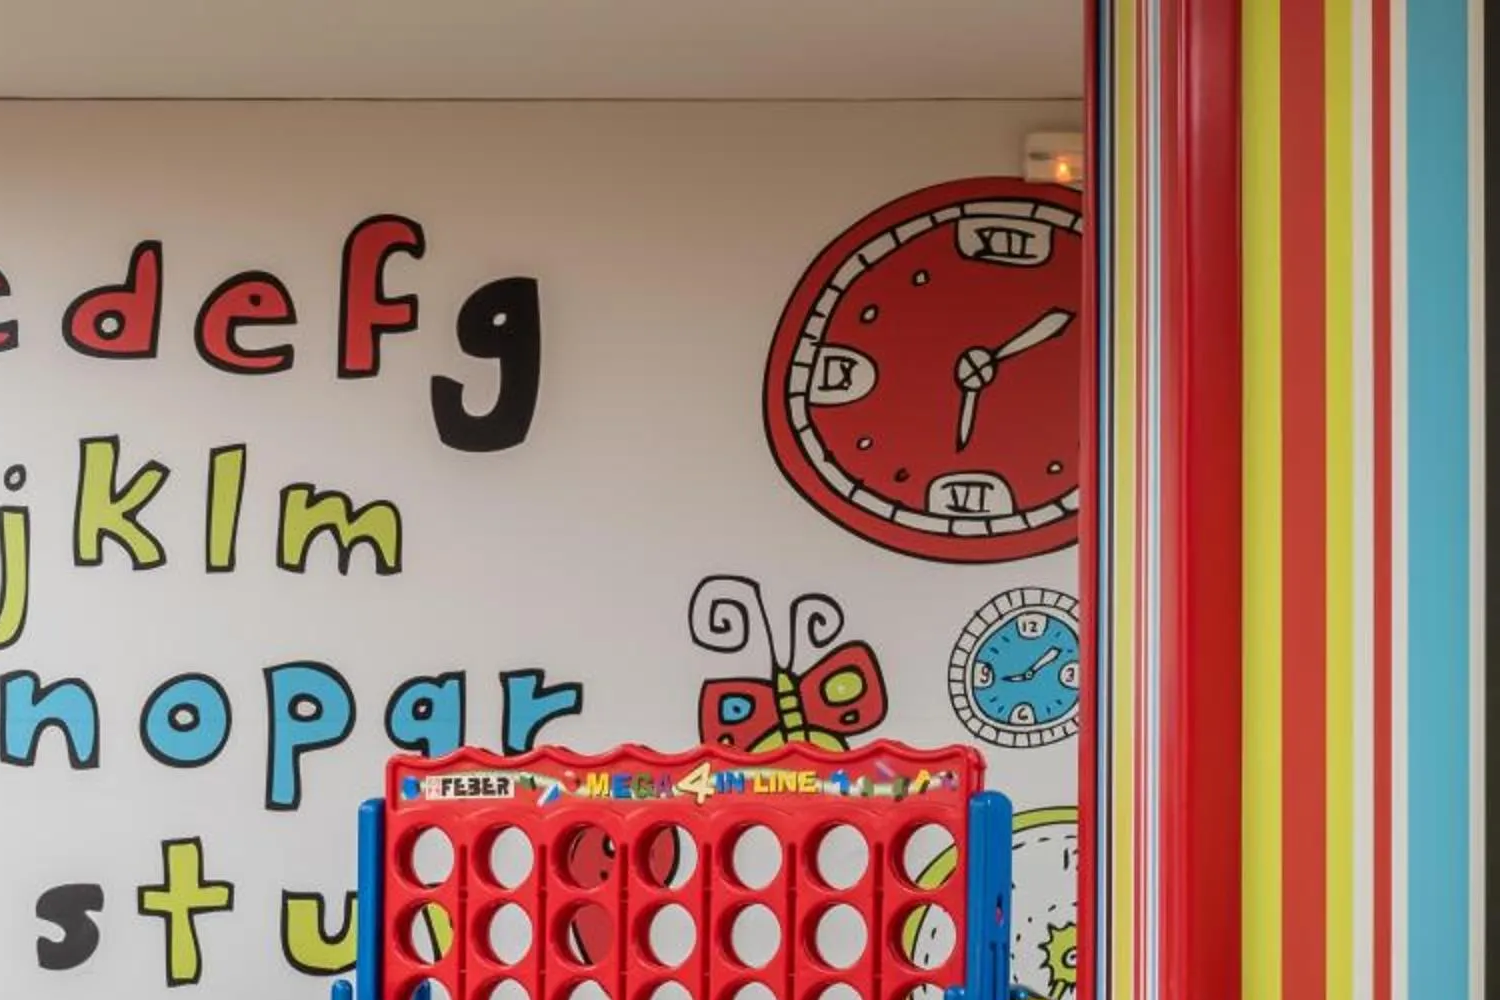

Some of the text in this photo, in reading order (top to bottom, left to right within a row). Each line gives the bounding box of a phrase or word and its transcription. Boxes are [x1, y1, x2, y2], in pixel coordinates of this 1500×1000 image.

[61, 239, 164, 360] d
[193, 270, 298, 376] e
[336, 213, 426, 380] f
[430, 276, 541, 453] g
[276, 481, 403, 576] m
[1021, 621, 1038, 633] 12
[979, 665, 1075, 683] 9 3
[1017, 706, 1028, 720] 6
[441, 762, 818, 804] FEBER MEGA 4 IN LINE
[137, 836, 235, 987] t
